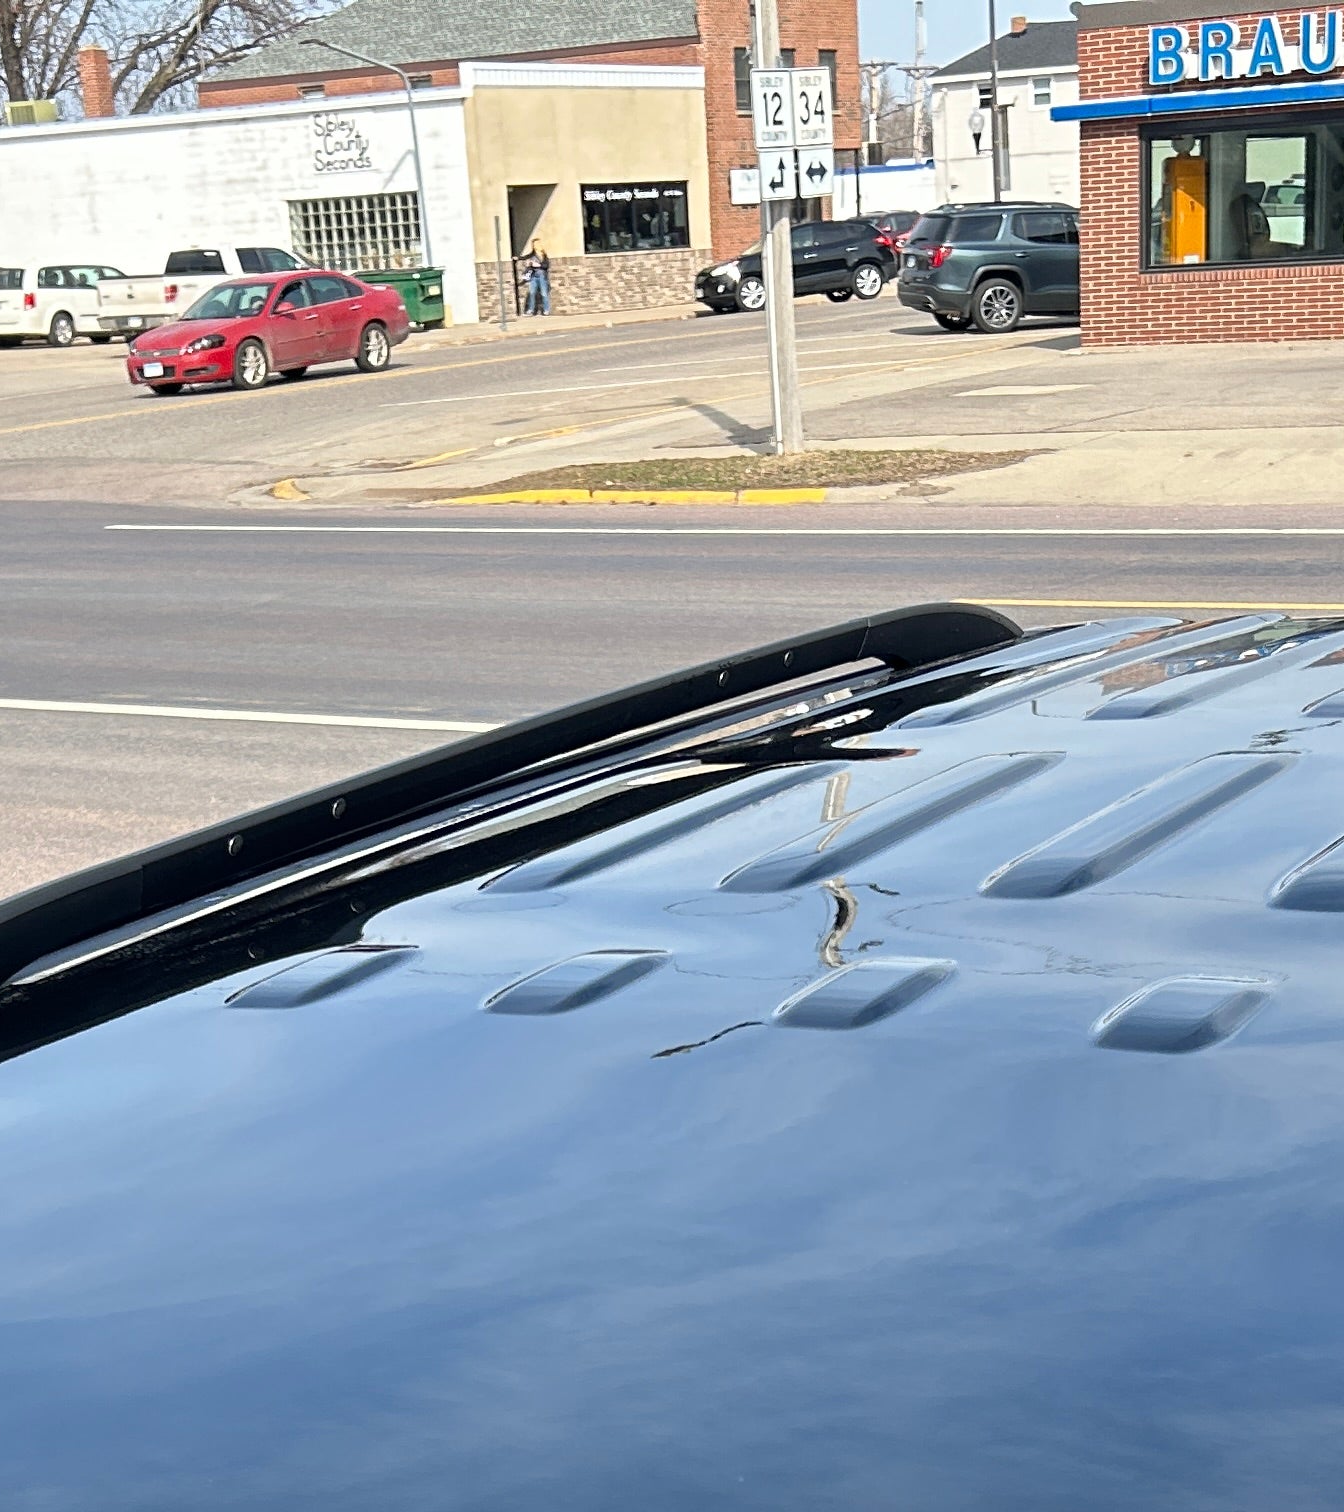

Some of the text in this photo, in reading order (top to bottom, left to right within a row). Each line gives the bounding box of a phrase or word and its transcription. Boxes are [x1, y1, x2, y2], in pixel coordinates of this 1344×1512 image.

[1149, 9, 1342, 85] BRAU
[763, 91, 783, 127] 12
[799, 90, 825, 125] 34
[313, 149, 372, 172] Seconds
[323, 131, 369, 156] County
